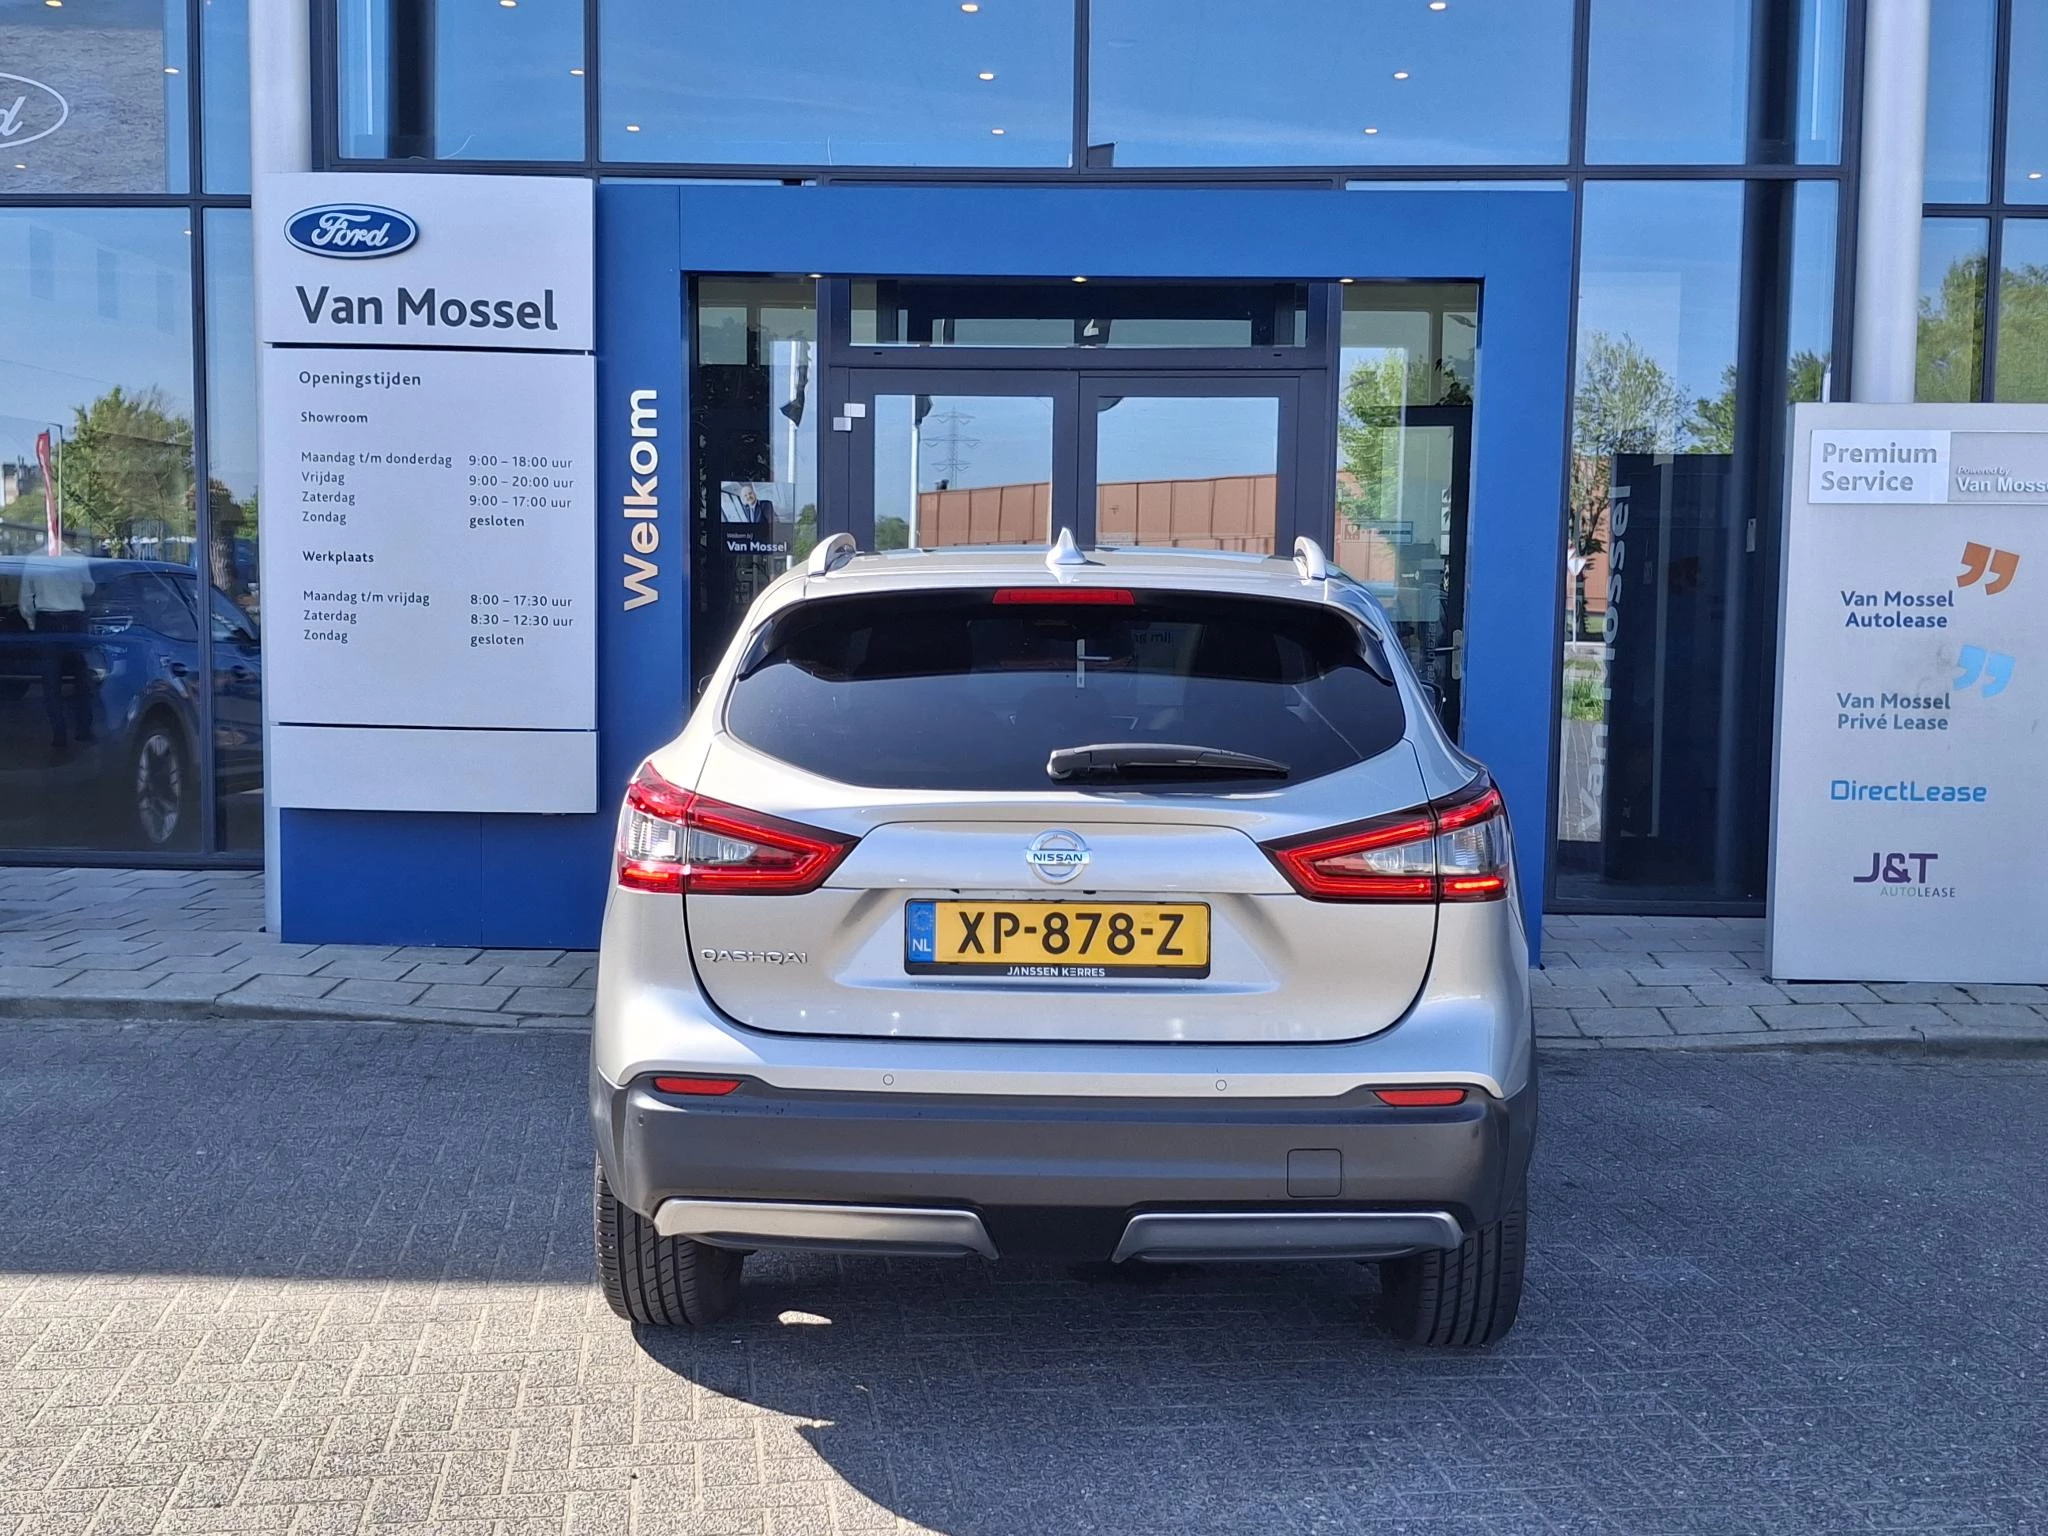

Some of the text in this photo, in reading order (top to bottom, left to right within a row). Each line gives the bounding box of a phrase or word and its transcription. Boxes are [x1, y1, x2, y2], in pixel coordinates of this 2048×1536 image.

[310, 212, 391, 247] Ford
[296, 285, 559, 331] Van Mossel
[299, 371, 422, 389] Openingstijden
[300, 411, 369, 424] Showroom
[1821, 441, 1938, 464] Premium
[301, 452, 453, 469] Maandag t/m donderdag
[469, 455, 498, 466] 9:00
[512, 456, 548, 468] 18:00
[552, 460, 573, 468] uur
[302, 471, 345, 485] Vrijdag
[1957, 466, 2010, 477] Powered by
[469, 475, 498, 486] 9:00
[512, 476, 549, 488] 20:00
[553, 480, 574, 489] uur
[1821, 470, 1914, 492] Service
[1957, 477, 2048, 493] Van Moss
[302, 491, 355, 506] Zaterdag
[469, 495, 498, 506] 9:00
[512, 496, 547, 507] 17:00
[551, 500, 572, 508] uur
[623, 389, 660, 612] Welkom
[302, 511, 347, 526] Zondag
[469, 515, 525, 528] gesloten
[727, 541, 787, 552] Van Mossel
[302, 551, 375, 565] Werkplaats
[303, 590, 430, 606] Maandag t/m vrijdag
[470, 594, 499, 605] 8:00
[514, 595, 548, 607] 17:30
[552, 599, 573, 607] uur
[1840, 590, 1954, 607] Van Mossel
[303, 609, 357, 624] Zaterdag
[470, 614, 499, 625] 8:30
[514, 615, 549, 626] 12:30
[553, 618, 574, 626] uur
[1845, 611, 1948, 628] Autolease
[303, 629, 348, 644] Zondag
[470, 633, 525, 647] gesloten
[1836, 692, 1951, 709] Van Mossel
[1837, 713, 1949, 730] Privé Lease
[1573, 723, 1609, 833] Van
[1830, 780, 1987, 802] DirectLease
[1033, 853, 1083, 862] NISSAN
[1853, 852, 1939, 884] J&T
[1880, 886, 1957, 898] AUTOLEASE
[957, 911, 1185, 956] XP-878-Z
[912, 939, 932, 953] NL
[701, 948, 808, 965] QASHQAI
[1006, 966, 1106, 977] JANSSEN KERRES
